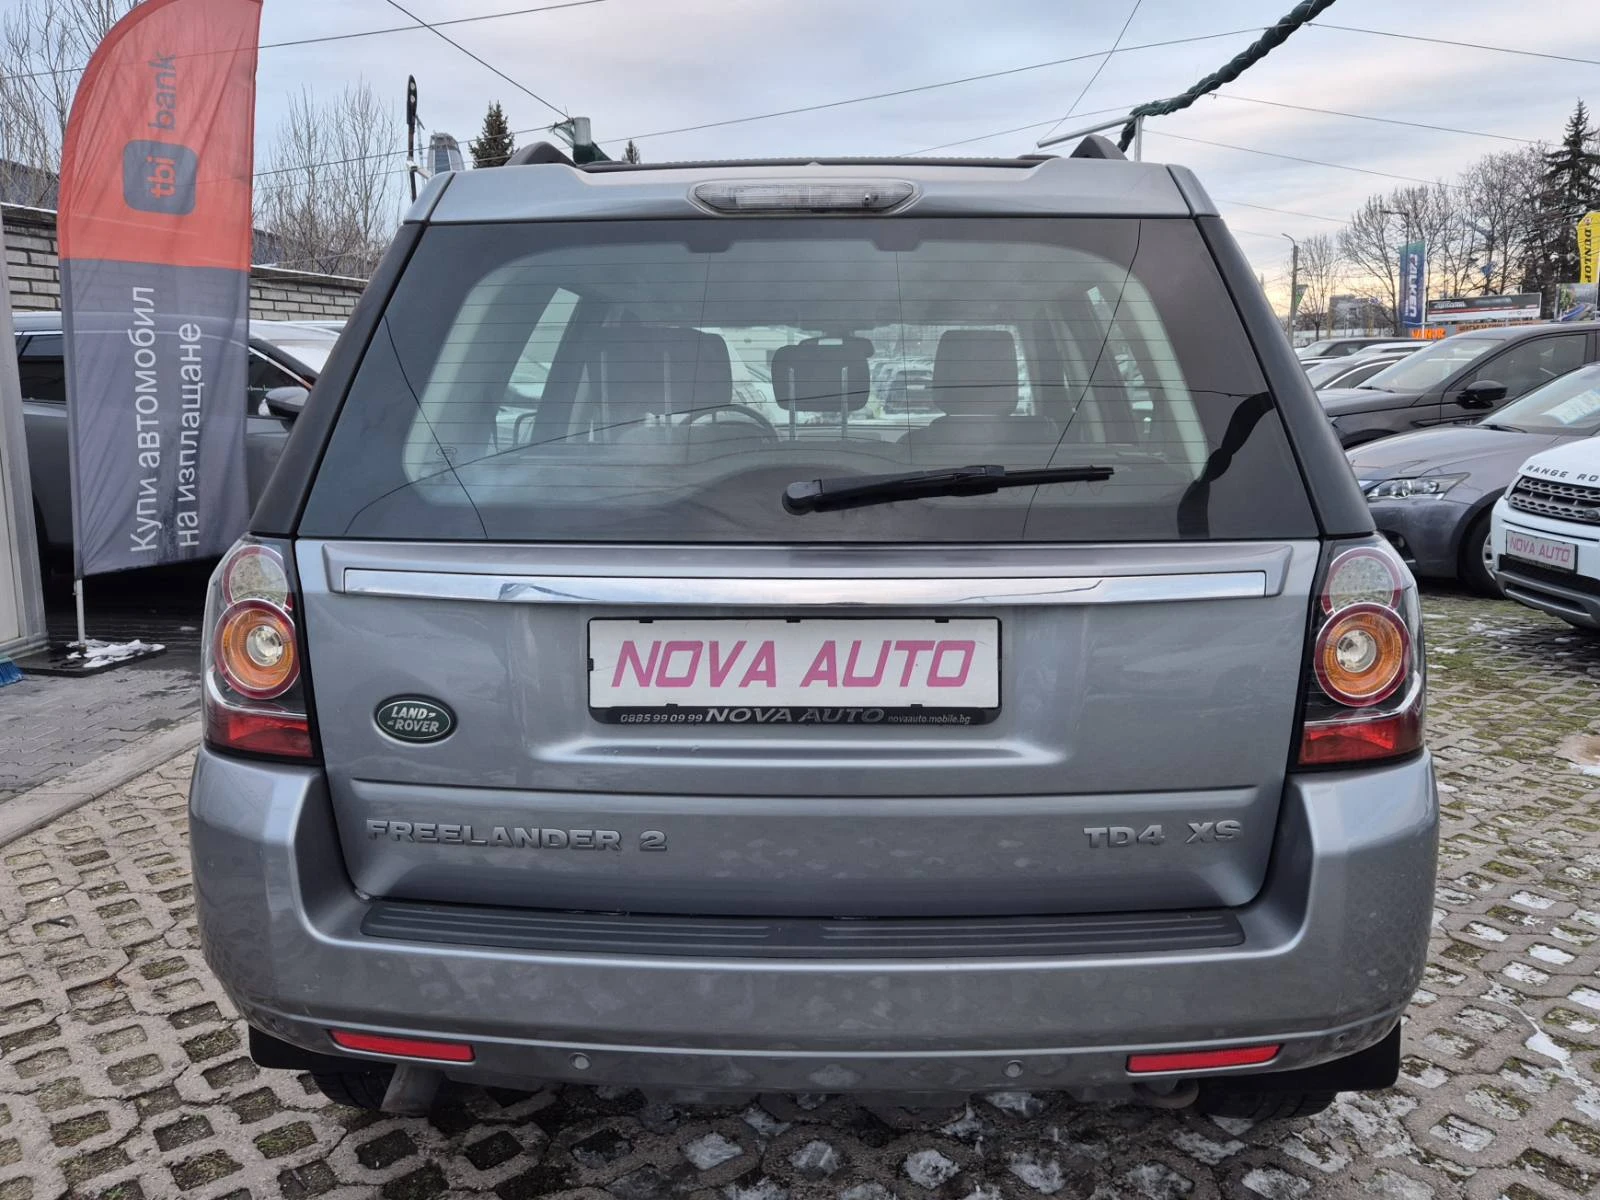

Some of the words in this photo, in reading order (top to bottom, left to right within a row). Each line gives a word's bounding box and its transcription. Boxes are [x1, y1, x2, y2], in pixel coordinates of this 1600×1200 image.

[147, 50, 177, 130] bank
[146, 155, 176, 199] tbi
[1584, 229, 1592, 283] DUNLOP
[1409, 253, 1418, 318] FALKEN
[128, 286, 161, 468] автомобил
[178, 322, 205, 502] изплащане
[1526, 464, 1569, 478] RANGE
[130, 478, 162, 552] Купи
[177, 511, 200, 547] на
[1510, 537, 1536, 555] NOVA
[1539, 543, 1571, 563] AUTO
[611, 639, 777, 688] NOVA
[799, 639, 976, 688] AUTO
[620, 714, 650, 723] 0885
[653, 713, 668, 722] 99
[670, 713, 685, 722] 09
[687, 713, 703, 722] 99
[705, 707, 793, 722] NOVA
[799, 707, 885, 723] AUTO
[366, 818, 622, 851] FREELANDER
[639, 829, 668, 851] 2
[1083, 824, 1165, 849] TD4
[1185, 819, 1241, 844] XS
